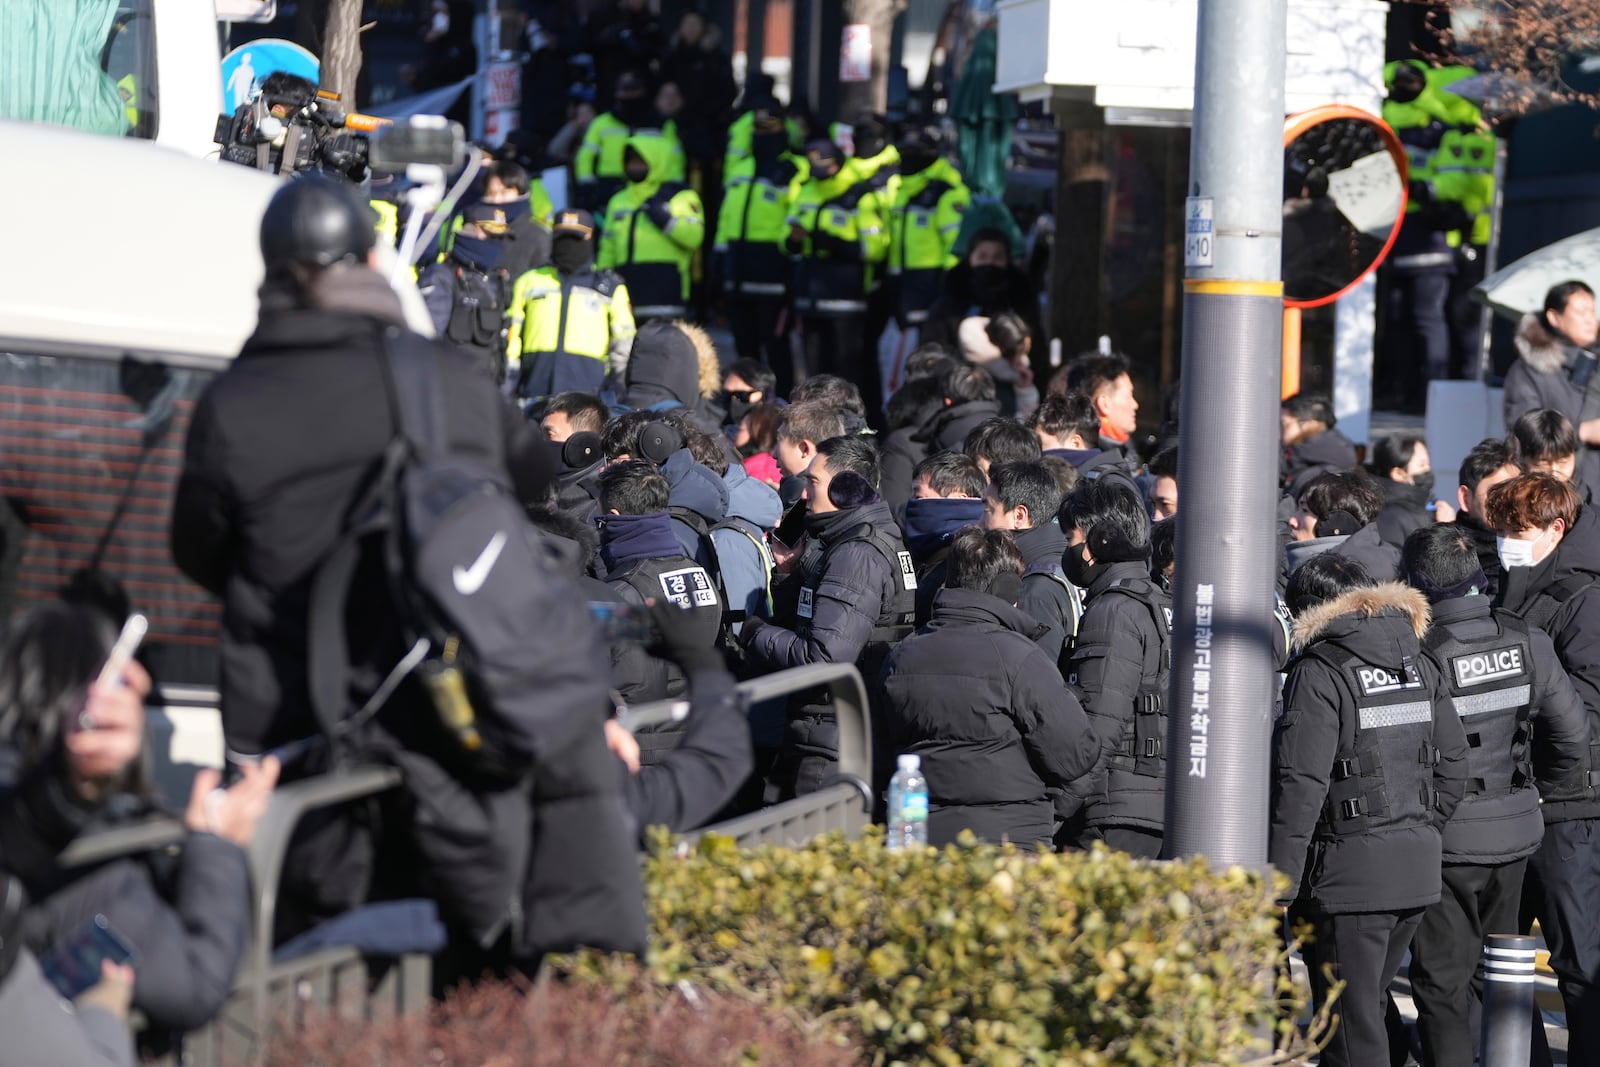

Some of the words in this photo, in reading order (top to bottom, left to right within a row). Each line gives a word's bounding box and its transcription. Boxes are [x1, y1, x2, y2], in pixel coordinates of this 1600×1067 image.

[668, 572, 708, 593] 경찰
[675, 591, 711, 605] POICE
[1457, 649, 1521, 678] POLICE
